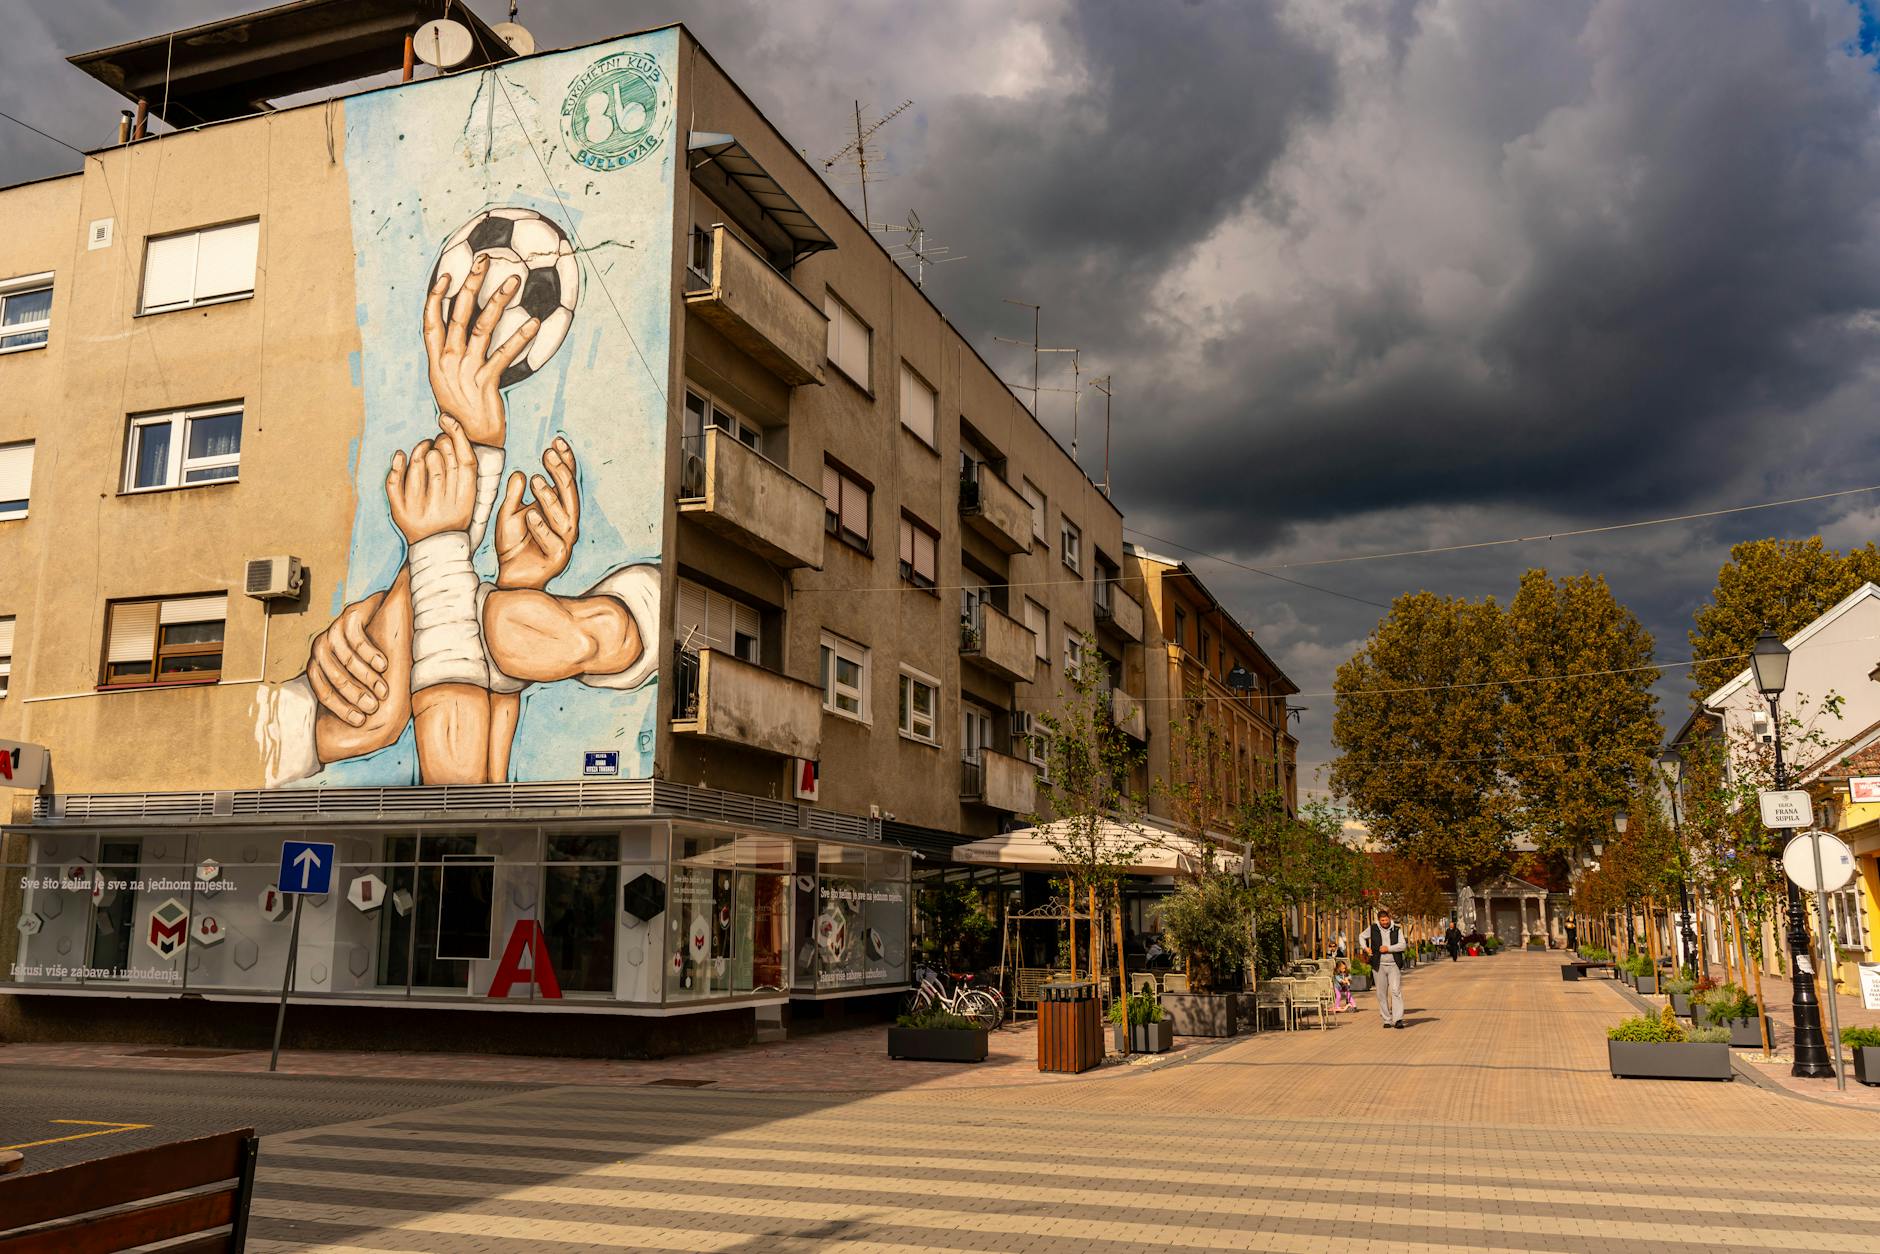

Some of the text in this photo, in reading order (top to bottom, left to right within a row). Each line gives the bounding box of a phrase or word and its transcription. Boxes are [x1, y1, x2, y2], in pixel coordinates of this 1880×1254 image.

[563, 56, 660, 116] RUKOMETNI KLUB
[577, 135, 657, 169] BJELOVAR
[20, 877, 238, 894] Sve što želim je sve na jednom mjestu.
[820, 887, 830, 899] Sve
[10, 963, 183, 983] Iskusi više zabave i uzbuđenja.
